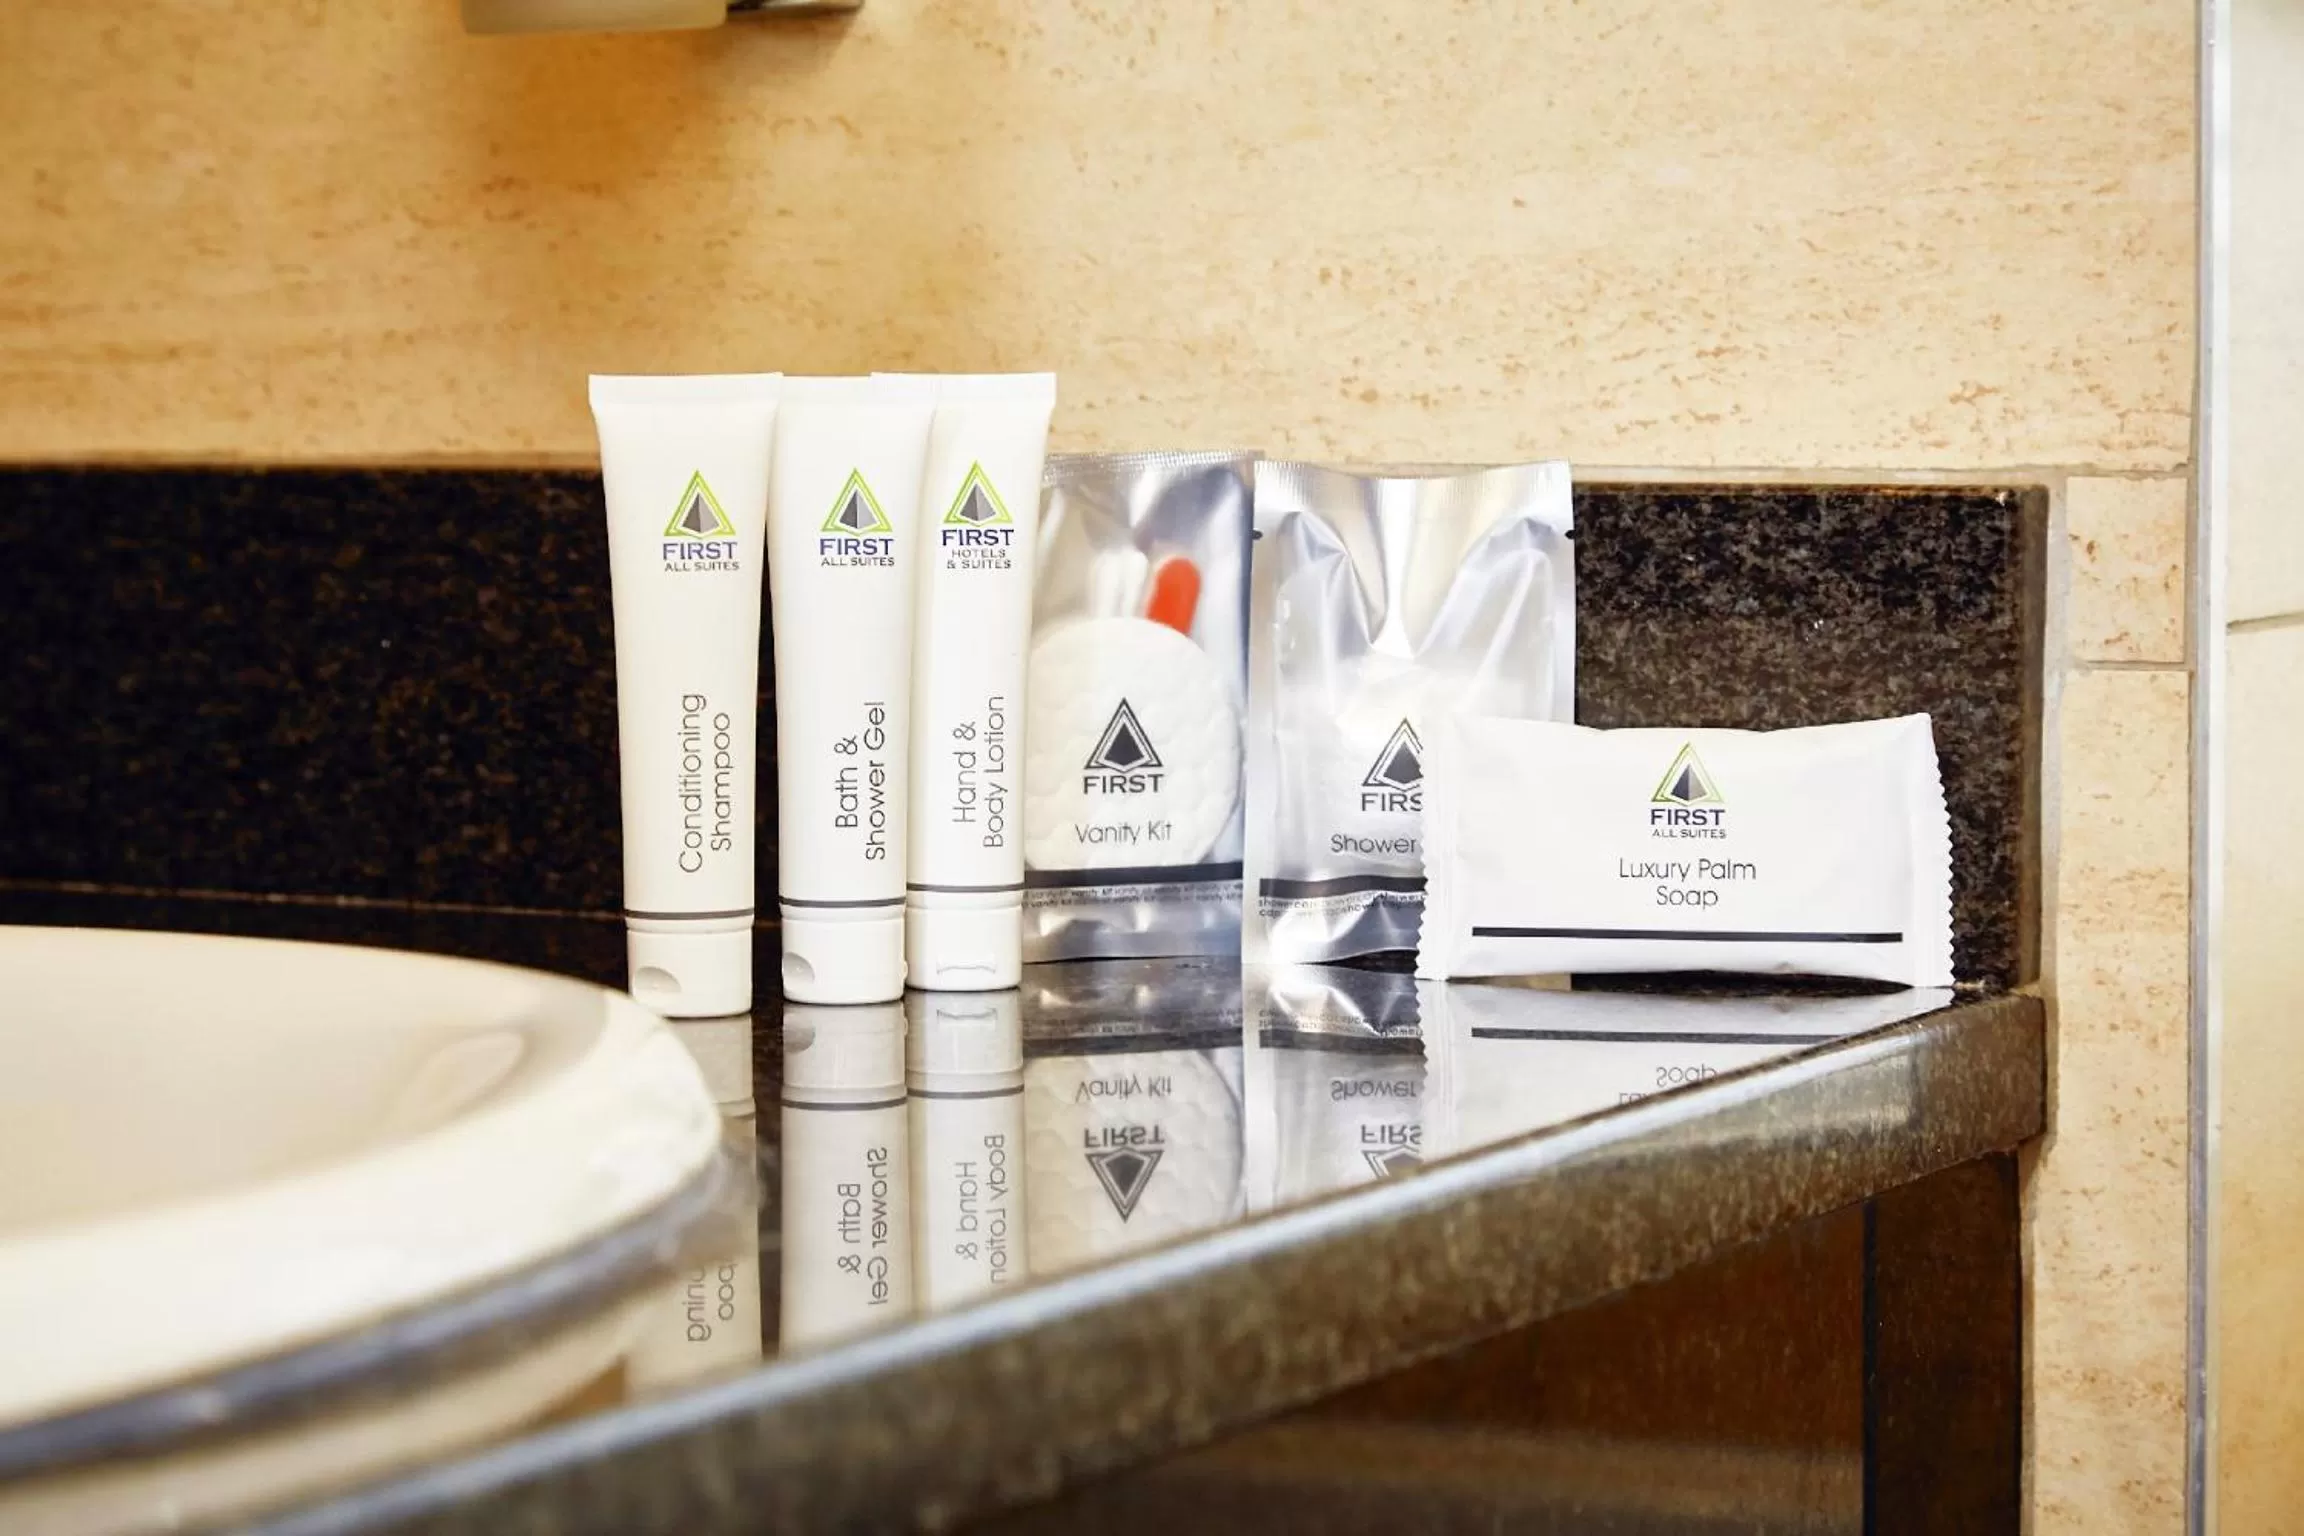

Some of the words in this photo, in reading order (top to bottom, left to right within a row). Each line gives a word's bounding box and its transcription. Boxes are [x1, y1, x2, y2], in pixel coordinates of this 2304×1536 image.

[819, 538, 894, 555] FIRST
[943, 528, 1015, 546] FIRST
[662, 541, 738, 560] FIRST
[951, 548, 1006, 558] HOTELS
[664, 561, 690, 572] ALL
[694, 560, 740, 572] SUITES
[820, 556, 847, 567] ALL
[849, 556, 895, 567] SUITES
[946, 559, 956, 570] &
[961, 559, 1012, 570] SUITES
[864, 702, 886, 751] Gel
[952, 721, 977, 742] &
[984, 696, 1005, 774] Lotion
[834, 735, 858, 756] &
[678, 694, 708, 874] Conditioning
[711, 712, 735, 852] Shampoo
[952, 751, 977, 823] Hand
[1083, 774, 1165, 794] FIRST
[835, 767, 858, 829] Bath
[1361, 792, 1424, 812] FIRS
[866, 759, 886, 861] Shower
[983, 783, 1009, 848] Body
[1650, 808, 1726, 826] FIRST
[1075, 823, 1141, 846] Vanity
[1147, 820, 1173, 841] Kit
[1330, 833, 1417, 854] Shower
[1651, 829, 1677, 838] ALL
[1680, 829, 1727, 839] SUITES
[1619, 857, 1691, 883] Luxury
[1699, 857, 1757, 880] Palm
[1656, 885, 1719, 910] Soap
